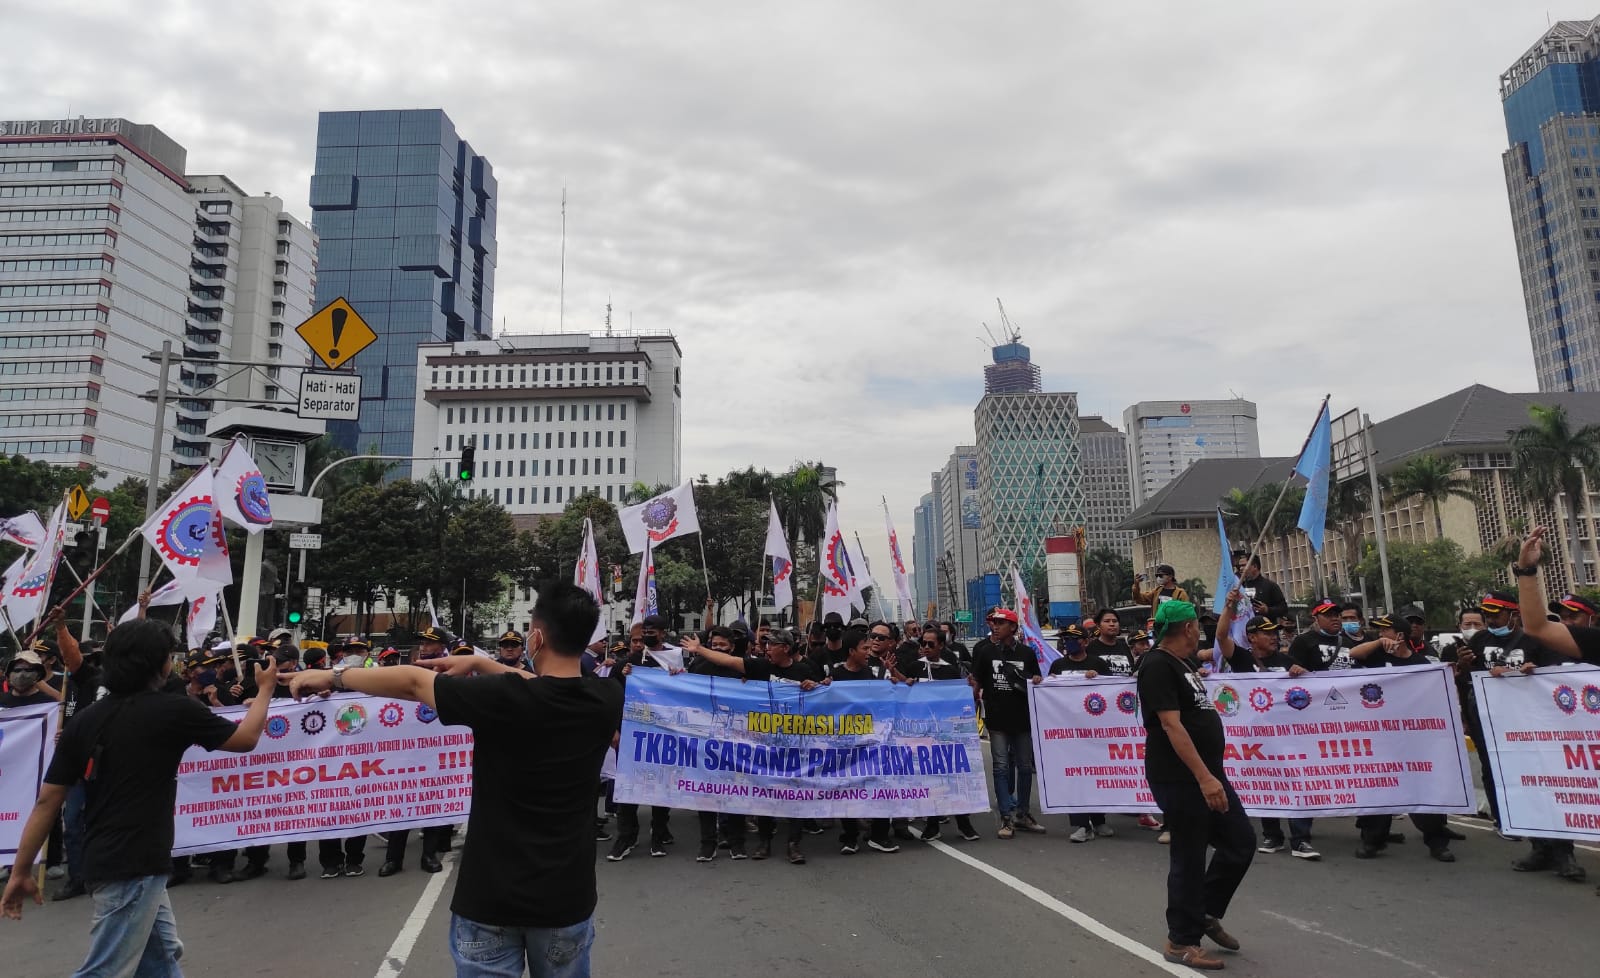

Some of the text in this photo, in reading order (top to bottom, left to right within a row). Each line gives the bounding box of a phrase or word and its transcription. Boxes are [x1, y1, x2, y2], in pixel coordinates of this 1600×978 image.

[52, 115, 120, 134] antara
[306, 380, 326, 392] Hati
[336, 382, 356, 394] Hati
[304, 398, 355, 413] Separator
[748, 711, 874, 736] KOPERASI JASA
[1044, 728, 1074, 740] KOPERASI
[1094, 726, 1130, 738] PELABUHAN
[1130, 726, 1137, 736] SE
[1276, 724, 1290, 736] DAN
[1292, 723, 1320, 735] TENAGA
[1320, 722, 1344, 734] KERJA
[1344, 720, 1380, 732] BONGKAR
[1381, 720, 1400, 731] MUAT
[1402, 718, 1446, 730] PELABUHAN
[179, 762, 194, 774] KBM
[197, 757, 238, 772] PELABUHAN
[240, 755, 248, 766] SE
[250, 752, 285, 766] INDONESIA
[287, 748, 316, 761] BERSAMA
[318, 745, 343, 758] SERIKAT
[402, 738, 416, 748] DAN
[418, 736, 442, 748] TENAGA
[444, 734, 464, 746] KERJA
[632, 731, 970, 778] TKBM SARANA PATIMBAN RAYA
[1318, 738, 1374, 758] !!!!!
[212, 758, 426, 794] MENOLAK....
[1065, 766, 1082, 776] RPM
[1084, 766, 1138, 776] PERHUBUNGAN
[1240, 767, 1282, 777] GOLONGAN
[1284, 766, 1300, 778] DAN
[1303, 764, 1351, 776] MEKANISME
[1354, 762, 1403, 774] PENETAPAN
[1406, 761, 1432, 772] TARIF
[678, 780, 929, 800] PELABUHAN PATIMBAN SUBANG JAWA BARAT
[1096, 778, 1138, 788] PELAYANAN
[1252, 780, 1272, 790] DARI
[1274, 780, 1290, 791] DAN
[1292, 780, 1303, 791] KE
[1304, 780, 1332, 790] KAPAL
[1334, 779, 1345, 789] DI
[1348, 776, 1399, 788] PELABUHAN
[1521, 776, 1536, 786] RPM
[1538, 776, 1598, 788] PERHUBUNGAN
[180, 797, 244, 814] PERHUBUNGAN
[246, 794, 282, 806] TENTANG
[284, 790, 308, 803] JENIS,
[311, 787, 352, 800] STRUKTUR,
[355, 781, 399, 794] GOLONGAN
[402, 778, 418, 790] DAN
[420, 776, 464, 788] MEKANISME
[1264, 794, 1277, 805] PP.
[1280, 795, 1293, 806] NO.
[1294, 796, 1300, 806] 7
[1302, 795, 1332, 806] TAHUN
[1334, 792, 1356, 804] 2021
[192, 812, 240, 828] PELAYANAN
[244, 809, 262, 822] JASA
[265, 805, 305, 818] BONGKAR
[308, 802, 328, 814] MUAT
[330, 798, 362, 812] BARANG
[364, 796, 384, 808] DARI
[388, 794, 404, 805] DAN
[406, 793, 416, 804] KE
[419, 790, 444, 802] KAPAL
[448, 789, 456, 798] DI
[238, 802, 464, 836] KARENA BERTENTANGAN DENGAN PP. NO. 7 TAHUN 2021
